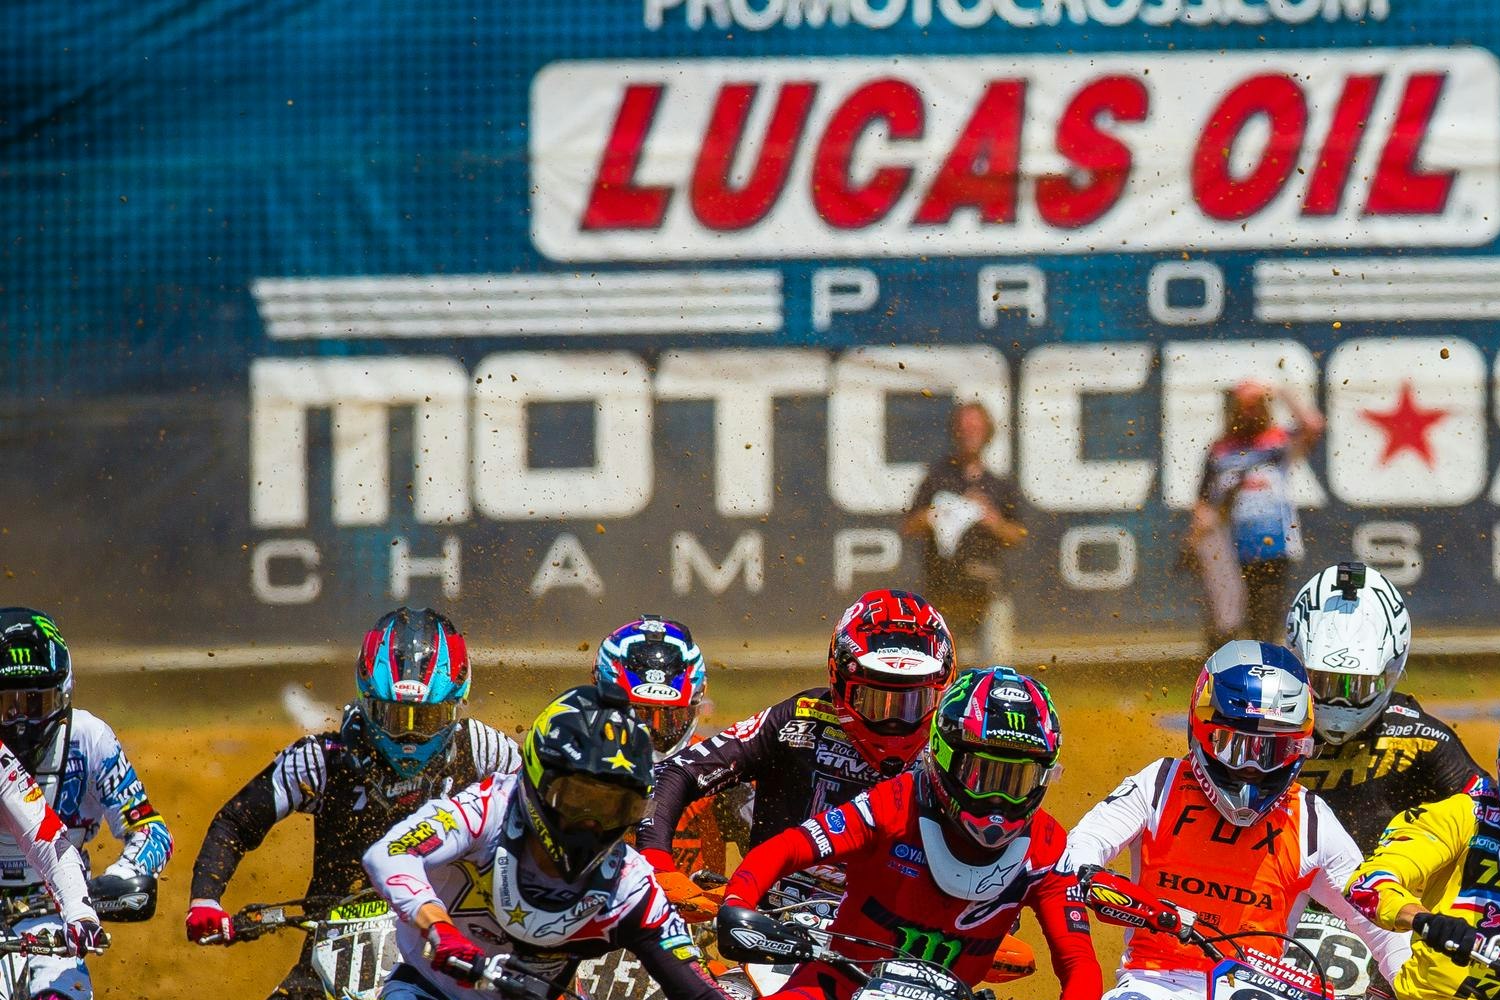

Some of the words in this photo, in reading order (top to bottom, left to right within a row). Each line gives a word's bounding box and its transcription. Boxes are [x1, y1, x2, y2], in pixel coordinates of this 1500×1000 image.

[581, 75, 1149, 231] LUCAS
[1193, 72, 1456, 221] OIL
[811, 261, 1223, 330] PRO
[996, 688, 1029, 701] Arai
[986, 729, 1046, 746] MONSTER
[831, 742, 859, 758] ROCK
[1173, 804, 1284, 855] FOX
[1156, 869, 1275, 911] HONDA
[1101, 906, 1145, 926] CYCRA
[1301, 912, 1329, 925] UCAS
[756, 938, 793, 953] CYCRA
[1250, 974, 1288, 992] LUCAS
